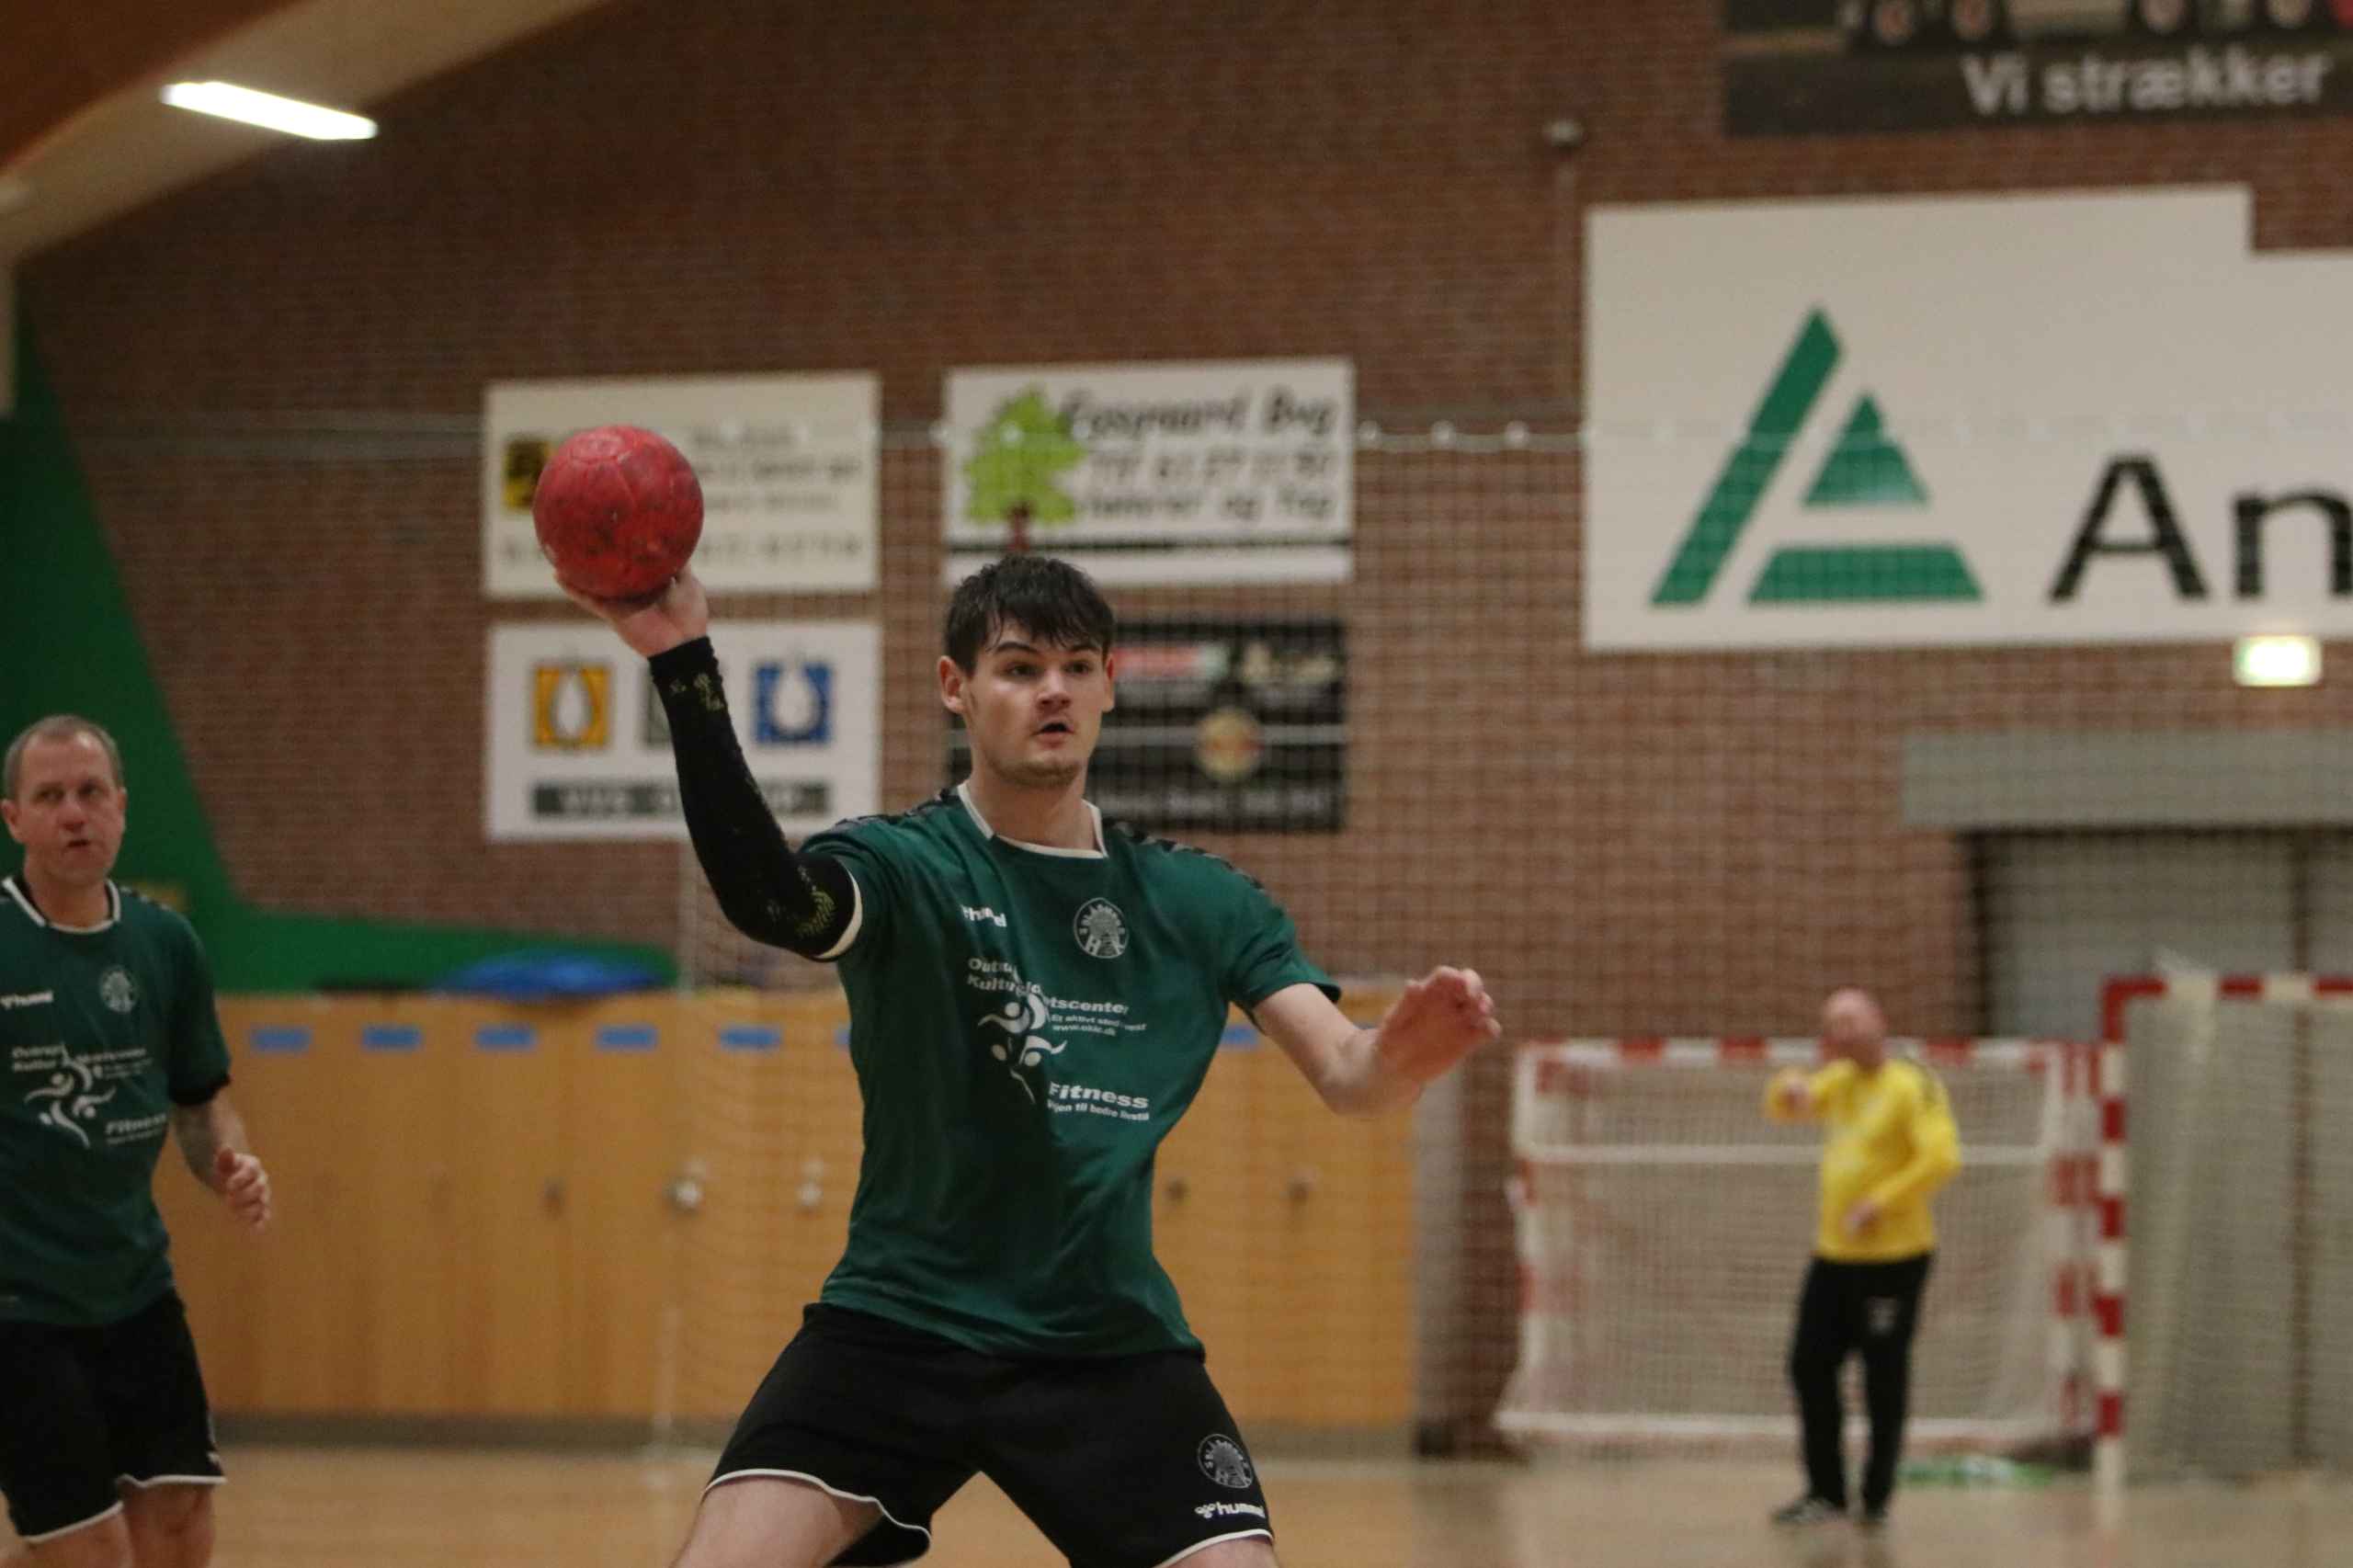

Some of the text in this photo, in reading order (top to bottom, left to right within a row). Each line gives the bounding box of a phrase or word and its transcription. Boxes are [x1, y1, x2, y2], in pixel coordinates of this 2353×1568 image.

[1960, 46, 2334, 116] Vi strækker
[1049, 1081, 1150, 1109] Fitness
